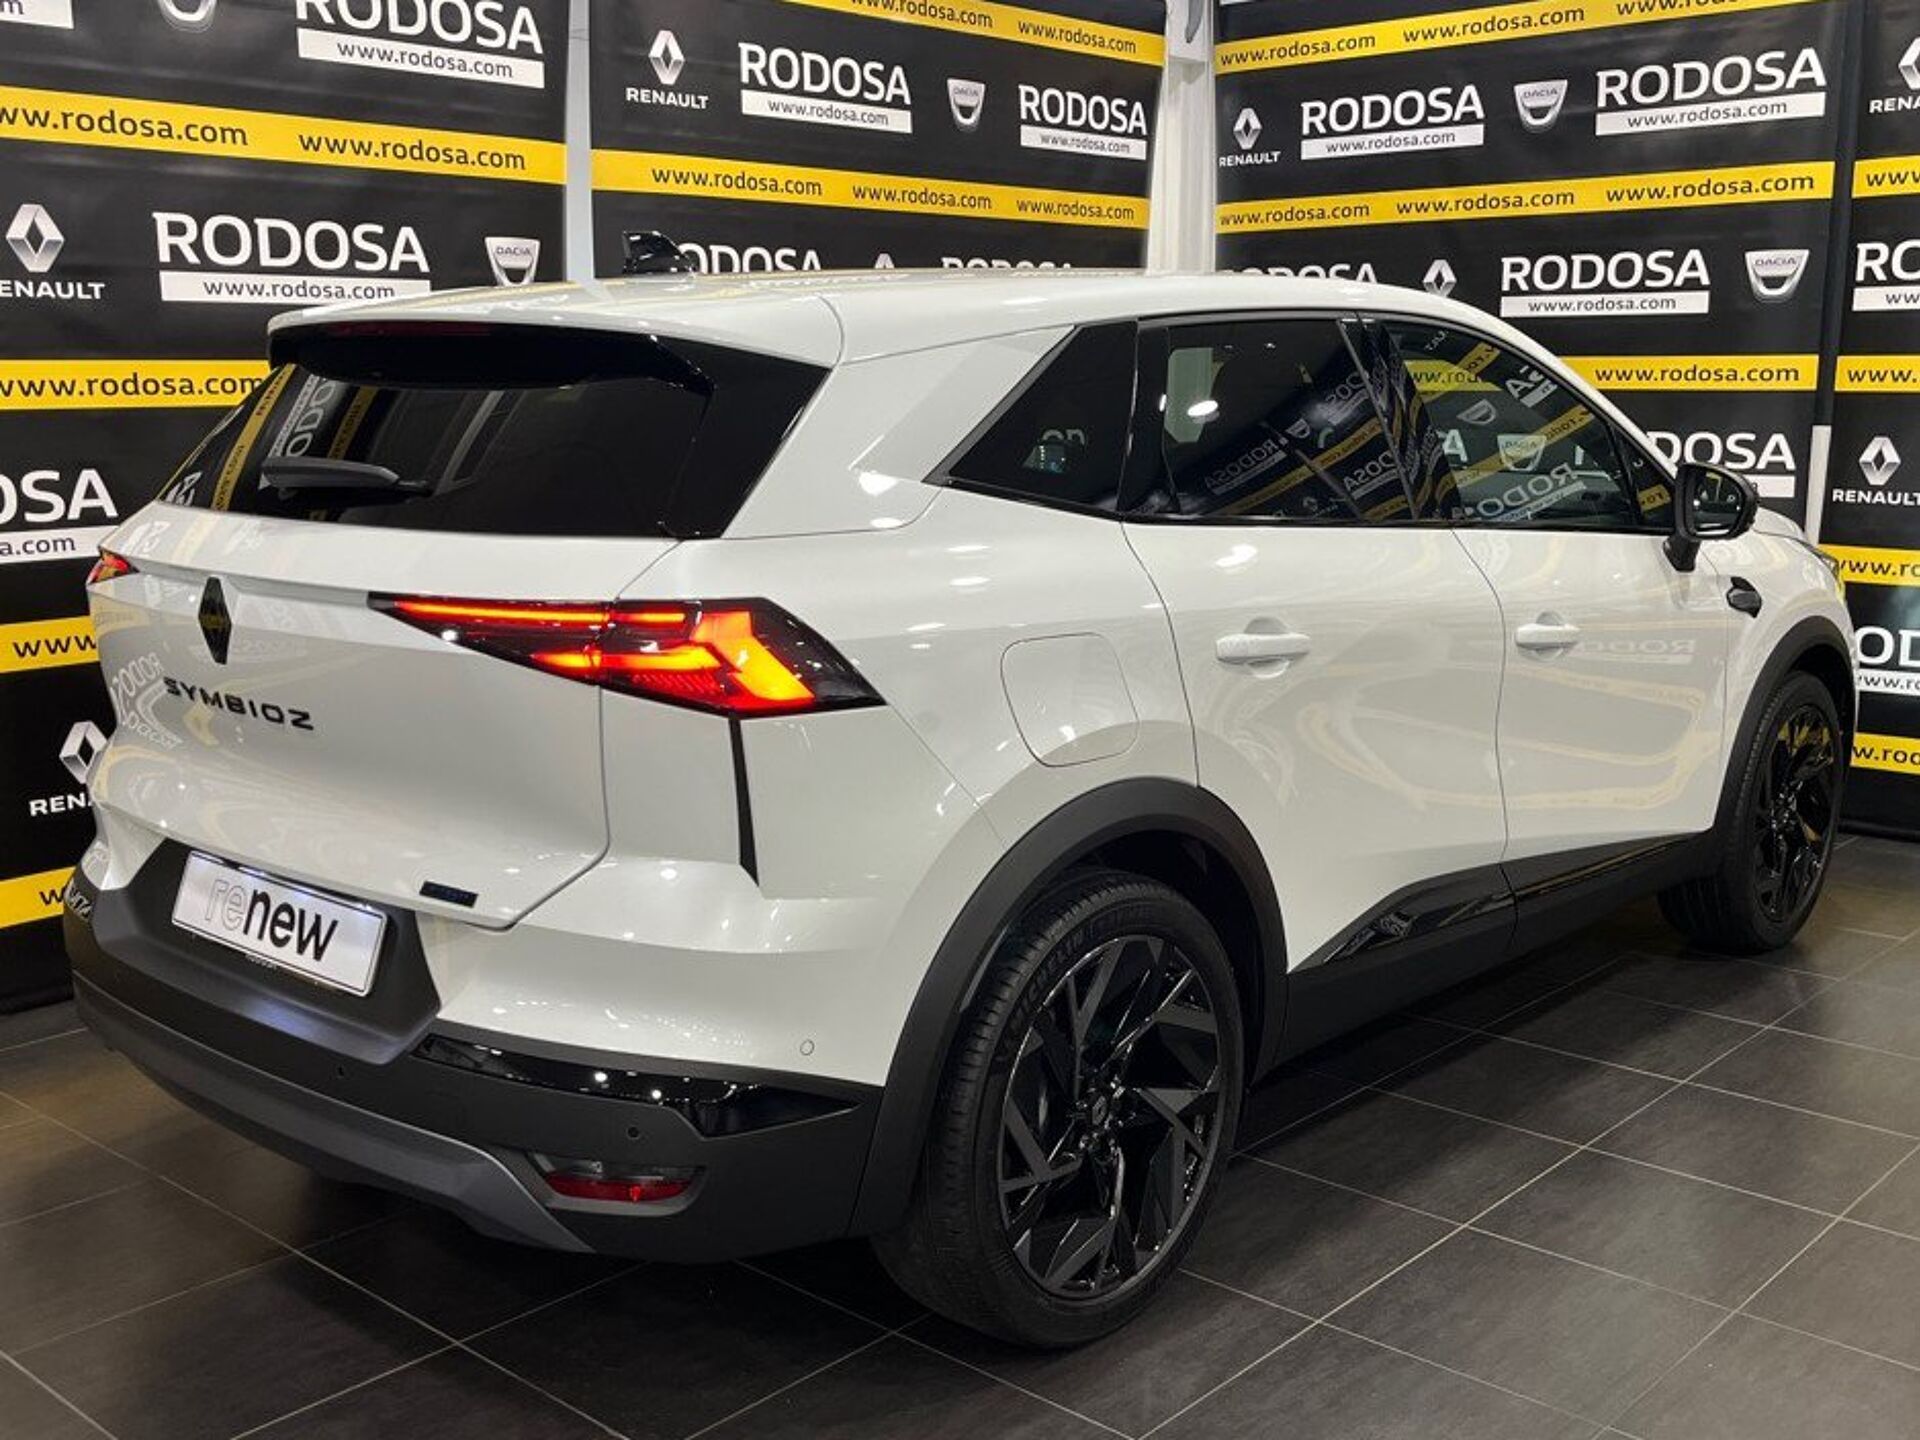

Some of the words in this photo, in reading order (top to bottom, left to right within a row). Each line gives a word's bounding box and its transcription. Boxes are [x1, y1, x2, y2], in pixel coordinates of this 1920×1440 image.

[1018, 19, 1136, 53] www.rodosa.com
[1403, 7, 1585, 42] www.rodosa.com
[338, 42, 514, 78] www.rodosa.com
[1221, 34, 1376, 65] www.rodosa.com
[738, 42, 911, 105] RODOSA
[1595, 48, 1827, 107] RODOSA
[626, 87, 708, 109] RENAULT
[768, 99, 889, 125] www.rodosa.com
[1018, 85, 1147, 136] RODOSA
[1301, 84, 1485, 136] RODOSA
[1627, 101, 1788, 128] www.rodosa.com
[299, 134, 526, 170] www.rodosa.com
[1040, 133, 1130, 155] www.rodosa.com
[1326, 131, 1456, 153] www.rodosa.com
[1219, 151, 1281, 167] RENAULT
[652, 168, 823, 196] www.rodosa.com
[1606, 173, 1815, 202] www.rodosa.com
[853, 184, 992, 210] www.rodosa.com
[1016, 197, 1134, 221] www.rodosa.com
[1396, 190, 1575, 215] www.rodosa.com
[1220, 203, 1370, 226] www.rodosa.com
[152, 212, 430, 273] RODOSA
[677, 243, 821, 274] ODOSA
[1501, 249, 1711, 291] RODOSA
[204, 280, 396, 300] www.rodosa.com
[1528, 297, 1677, 313] www.rodosa.com
[1595, 363, 1801, 382] www.rodosa.com
[163, 676, 314, 731] SYMBIOZ
[204, 878, 339, 962] renew
